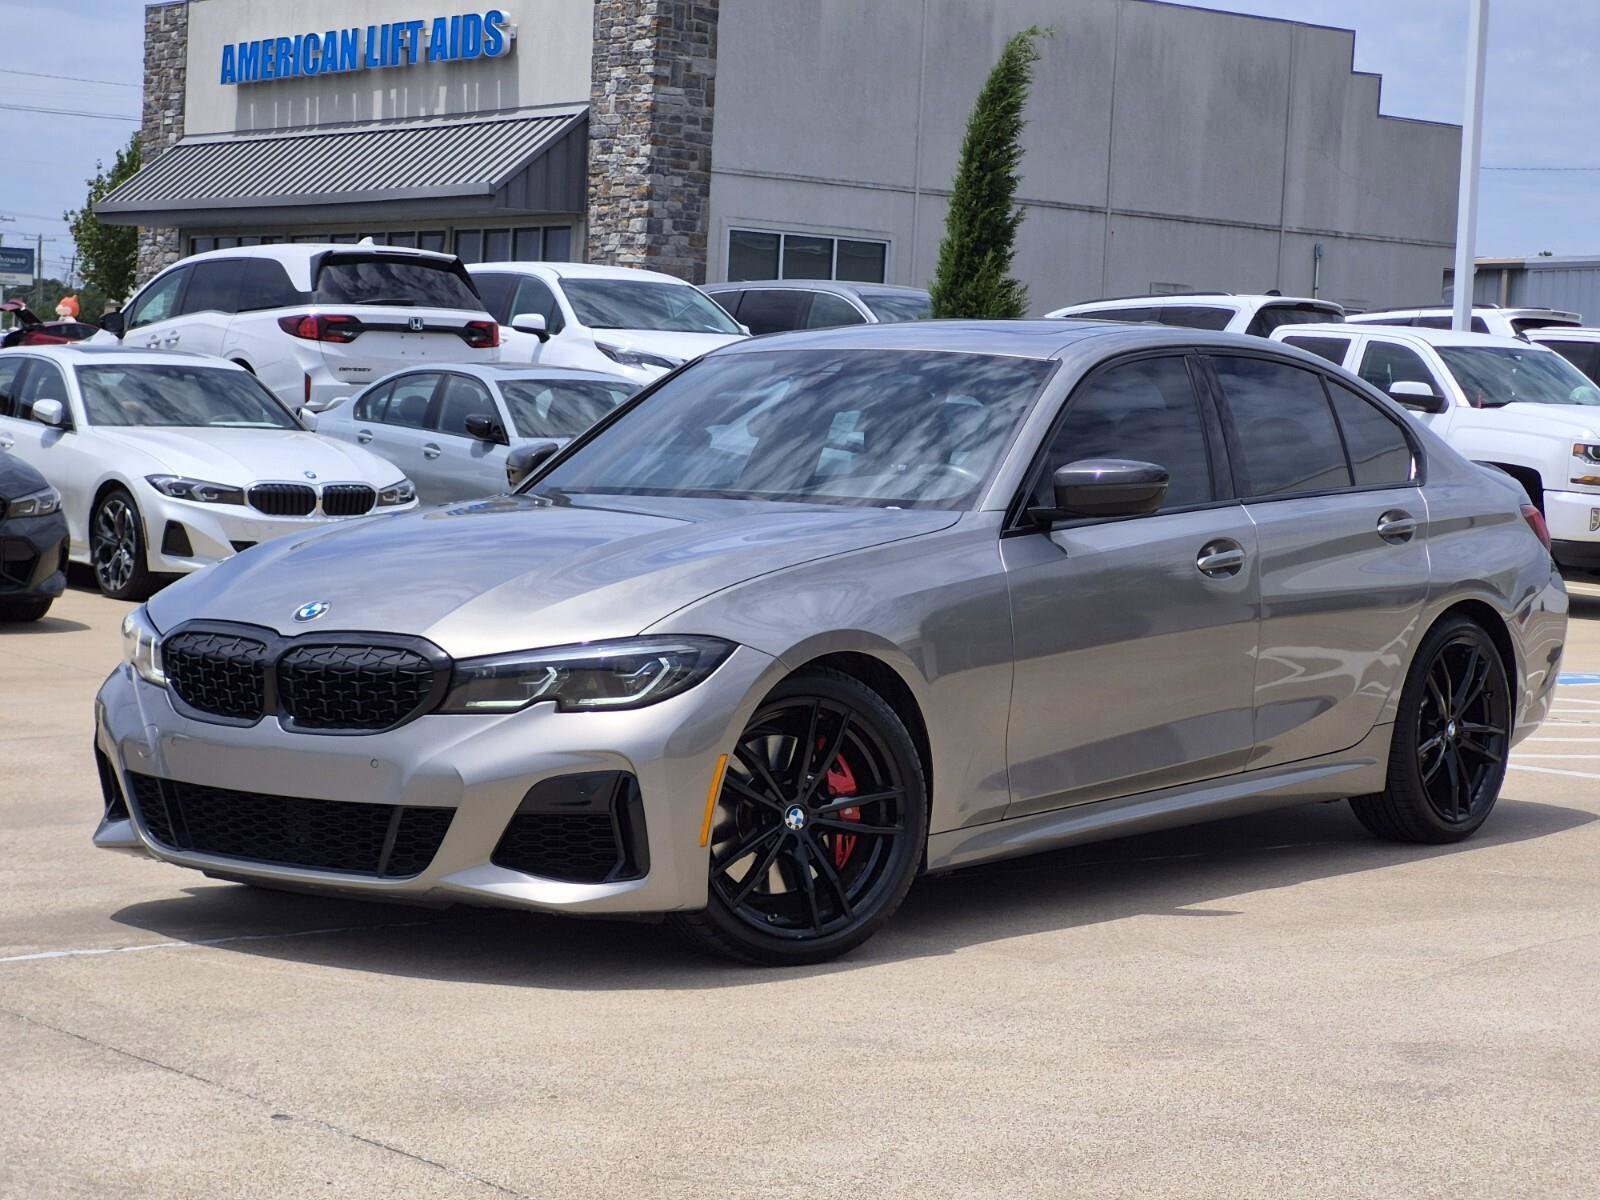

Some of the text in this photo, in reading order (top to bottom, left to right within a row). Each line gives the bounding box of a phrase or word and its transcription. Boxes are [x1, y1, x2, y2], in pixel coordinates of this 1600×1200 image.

[220, 10, 506, 85] AMERICAN LIFT AIDS
